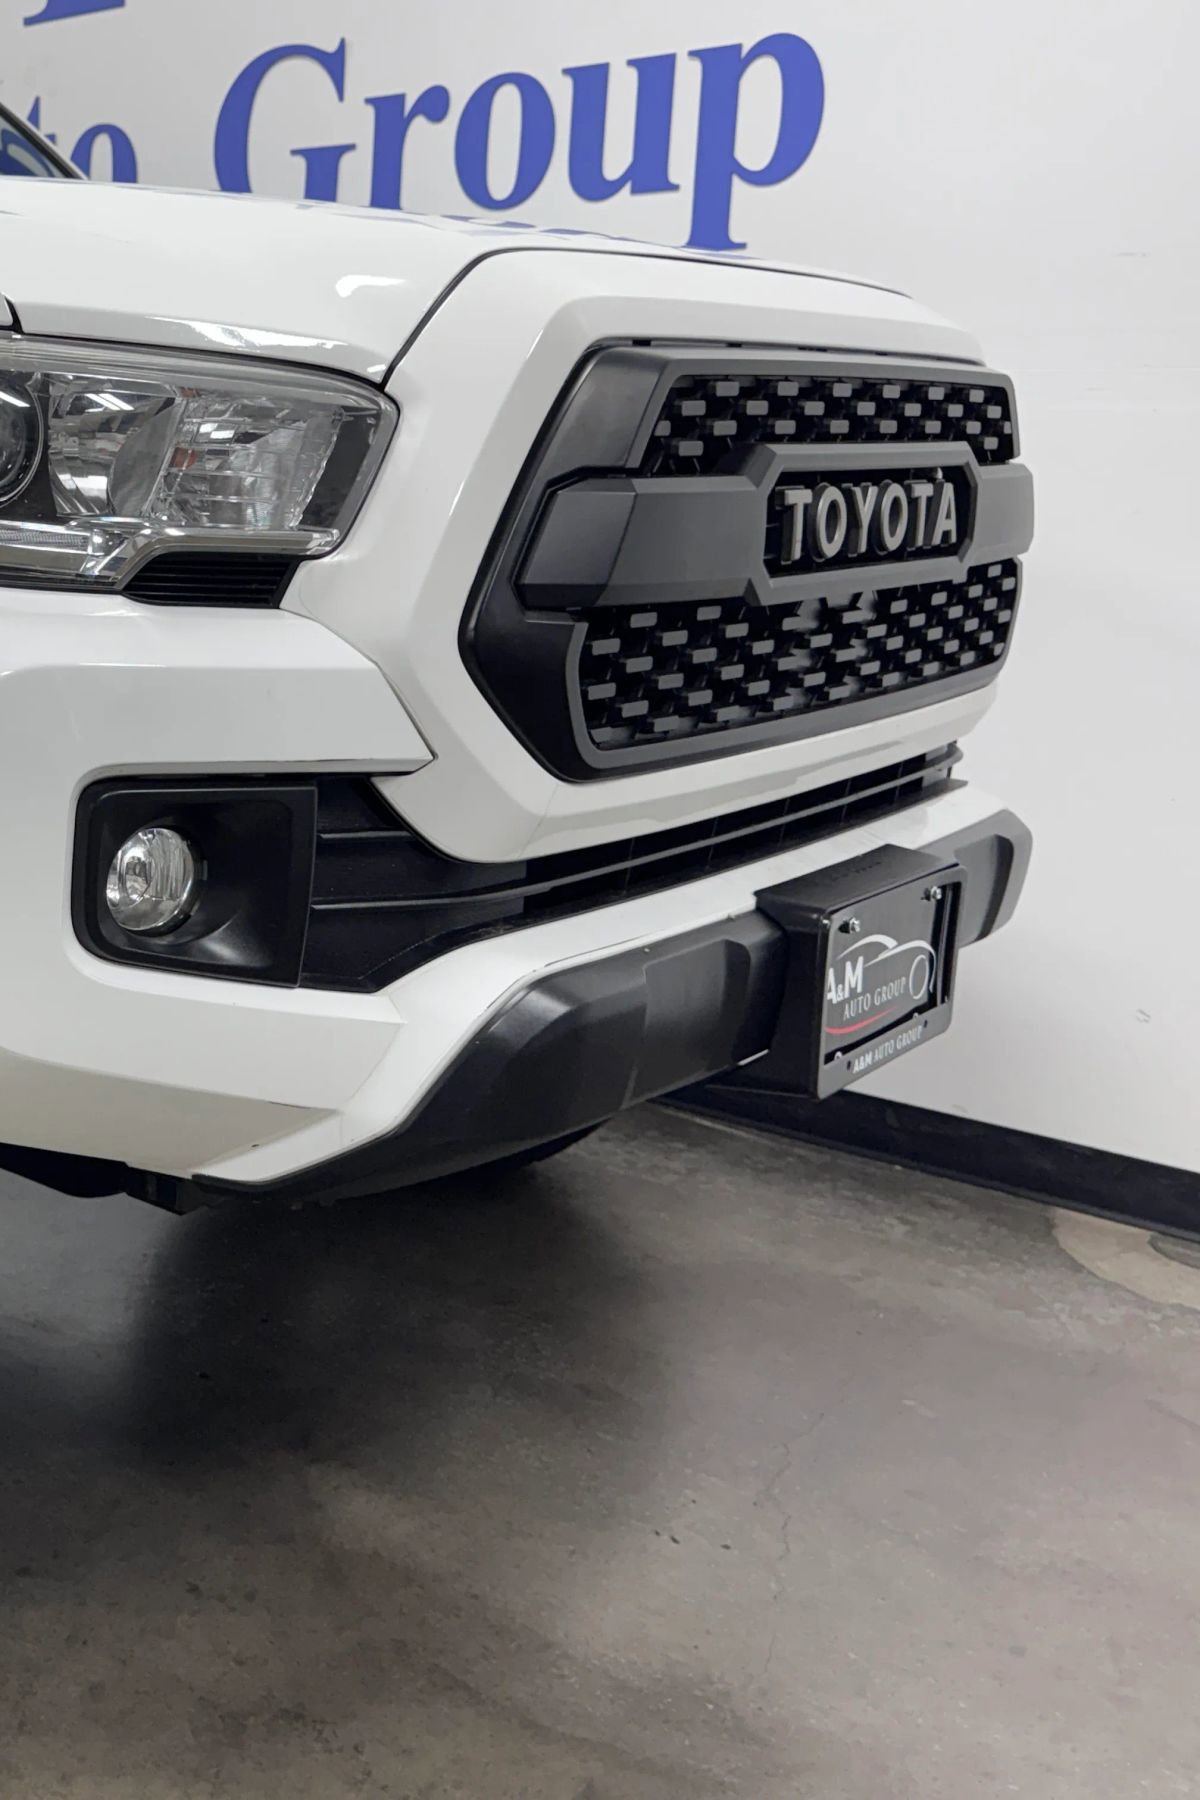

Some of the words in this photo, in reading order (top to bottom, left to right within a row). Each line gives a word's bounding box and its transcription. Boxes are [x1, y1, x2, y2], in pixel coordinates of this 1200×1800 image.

[213, 33, 826, 250] Group
[779, 481, 958, 562] TOYOTA
[826, 955, 864, 1005] A&M
[843, 993, 872, 1021] AUTO
[873, 976, 907, 1006] GROUP
[852, 1050, 873, 1074] A&M
[874, 1040, 895, 1062] AUTO
[896, 1025, 923, 1050] GROUP
